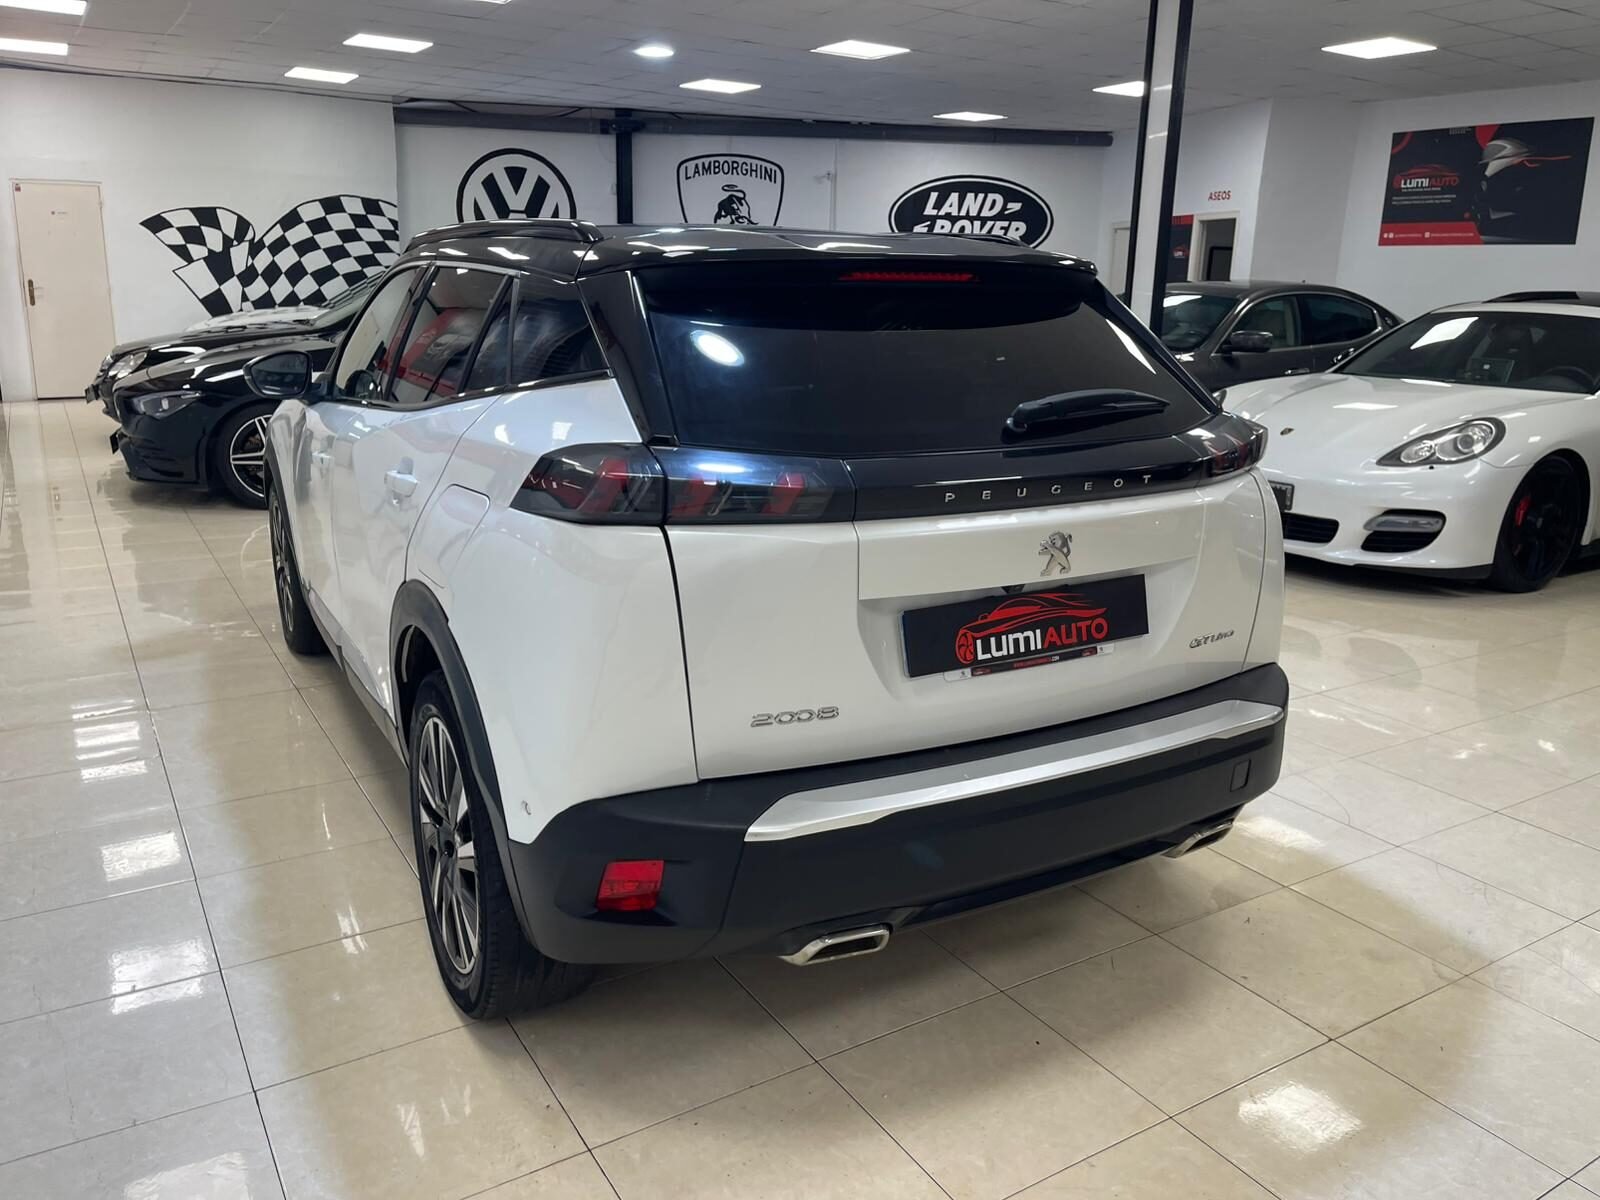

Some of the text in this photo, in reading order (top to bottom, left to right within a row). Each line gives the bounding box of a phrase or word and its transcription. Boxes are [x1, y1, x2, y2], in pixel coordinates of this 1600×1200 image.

[685, 160, 777, 184] LAMBORGHINI
[1207, 189, 1232, 201] ASEOS
[944, 475, 1151, 502] PEUGEOT
[751, 706, 840, 728] 2008
